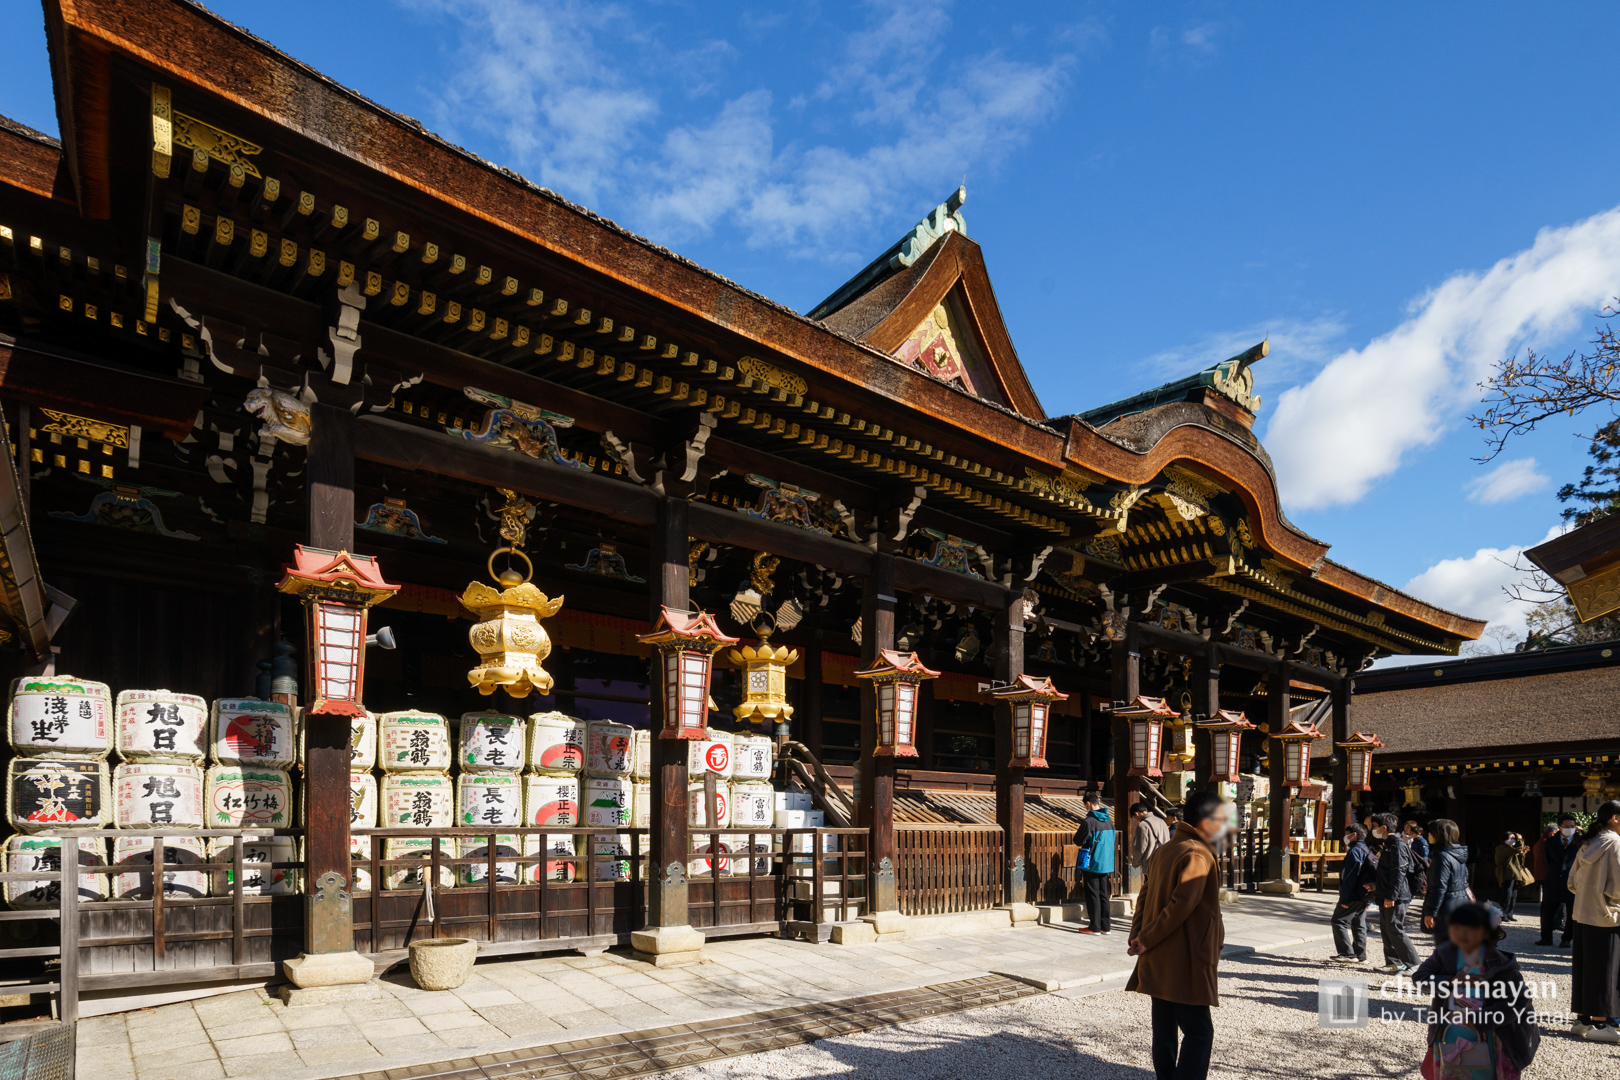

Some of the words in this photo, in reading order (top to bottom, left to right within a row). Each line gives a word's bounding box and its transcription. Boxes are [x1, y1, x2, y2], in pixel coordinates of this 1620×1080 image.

[145, 702, 184, 750] 旭日
[484, 727, 508, 765] 長老
[141, 776, 181, 823] 旭日
[222, 792, 280, 811] 松竹梅
[482, 788, 505, 824] 長老
